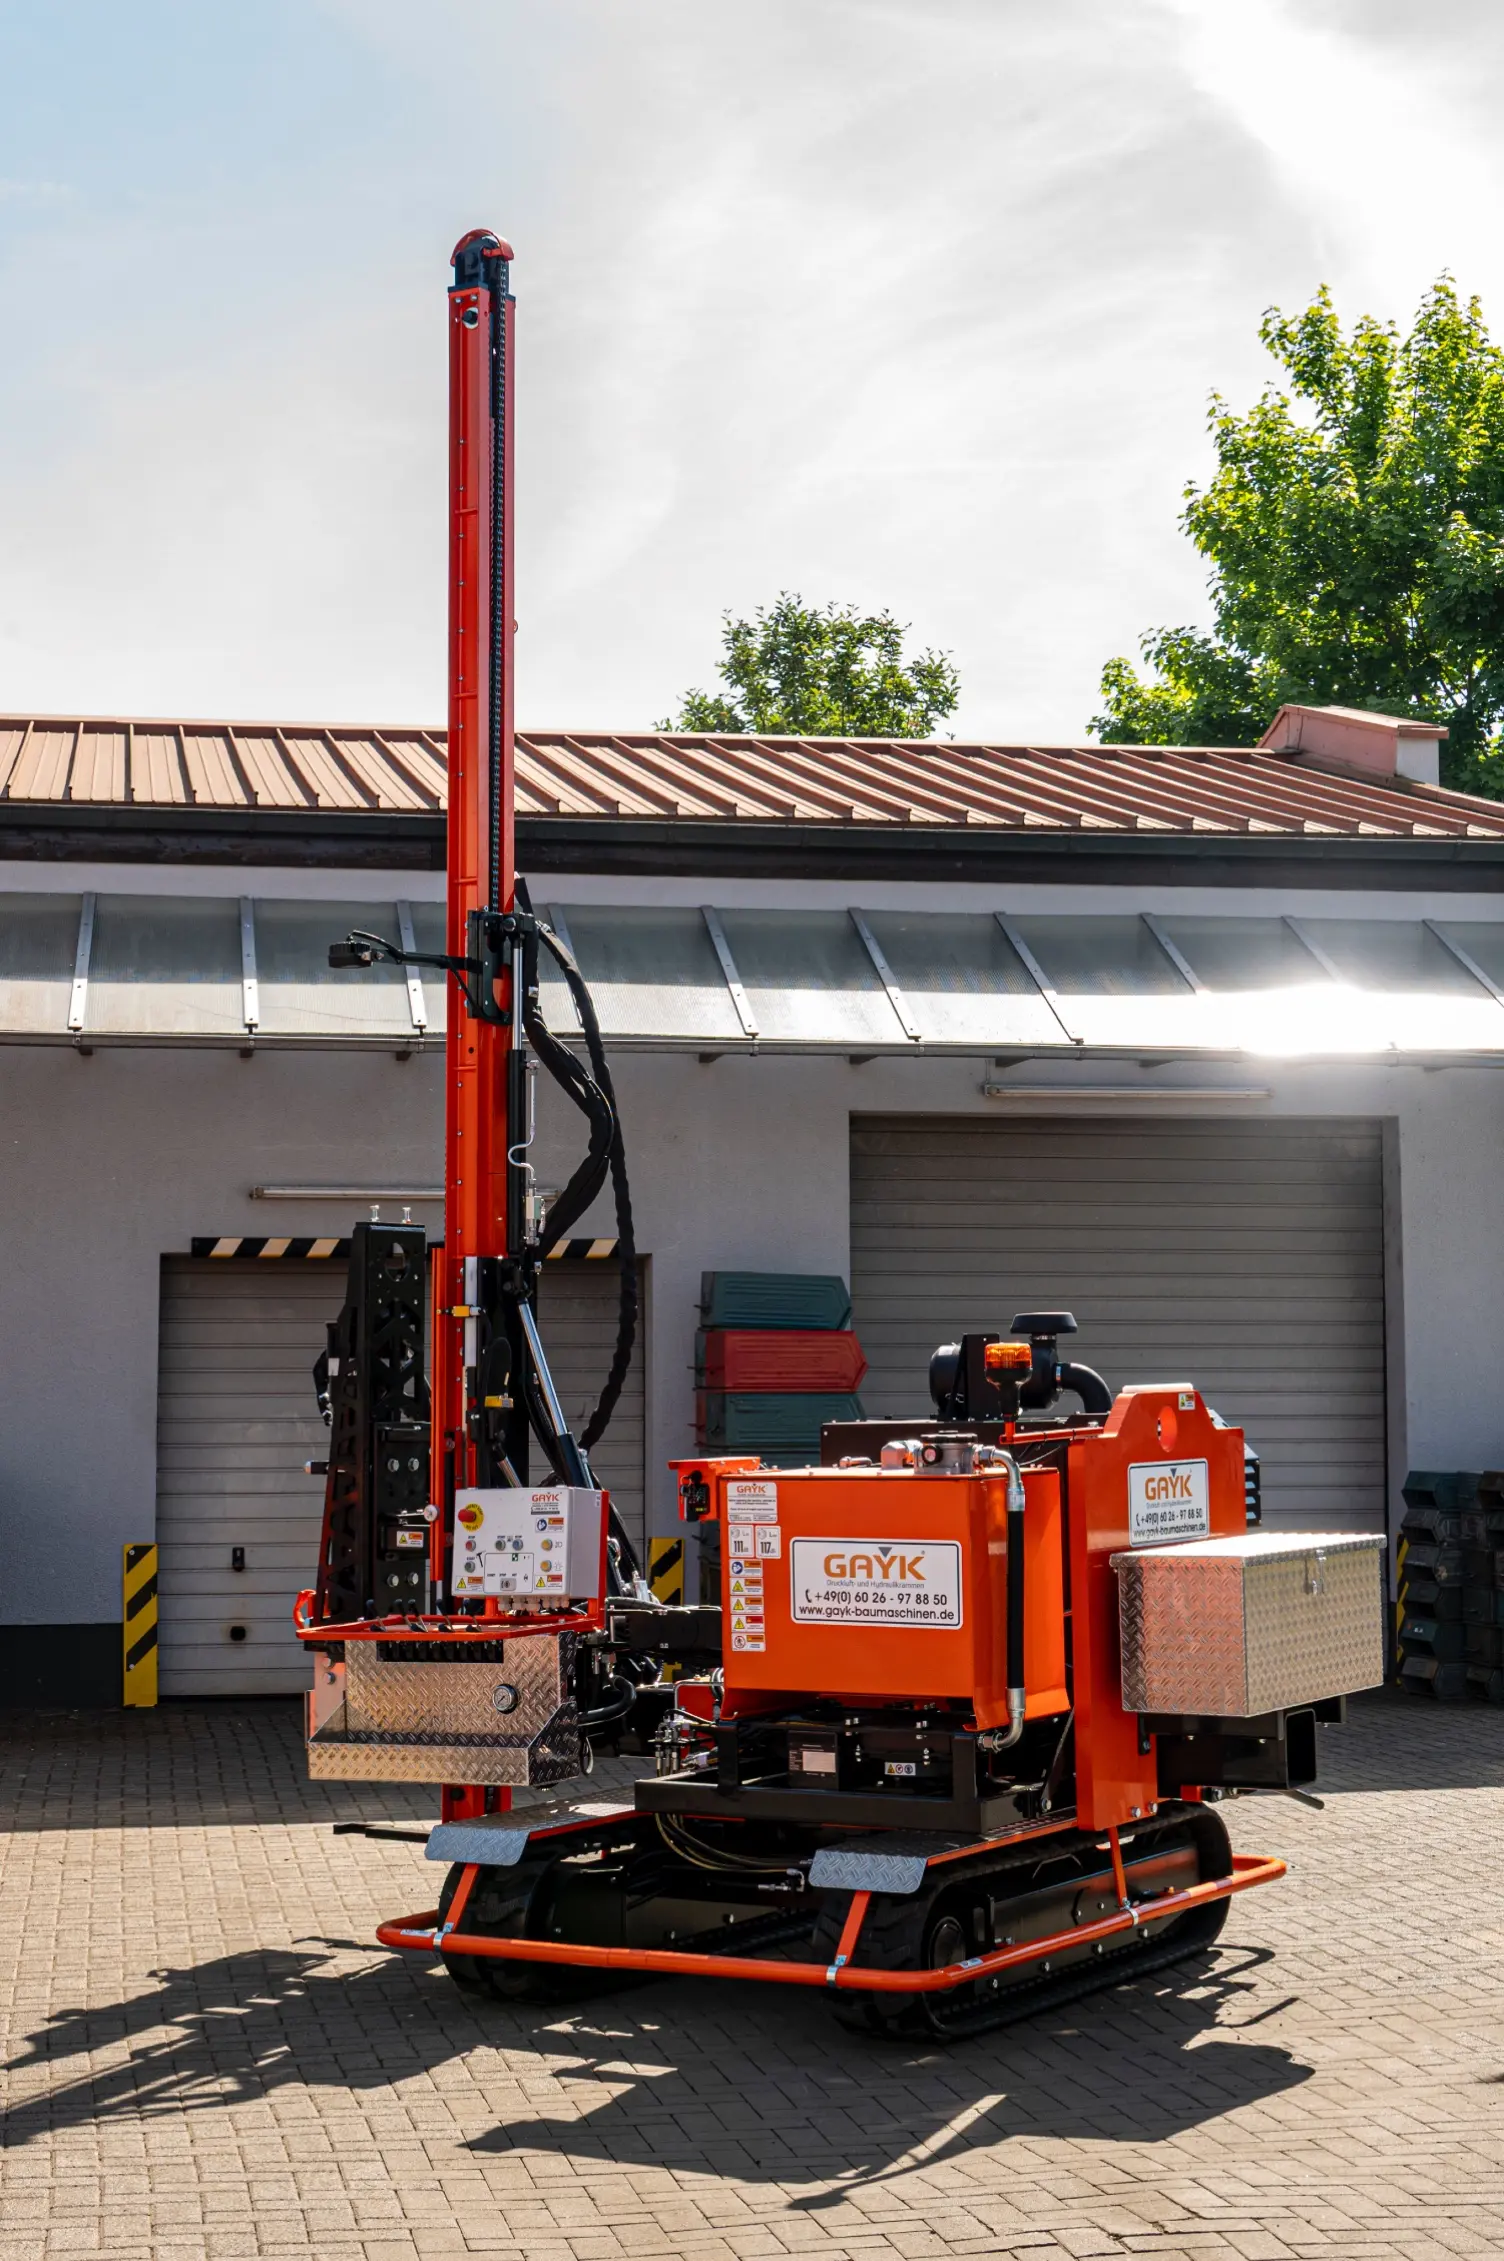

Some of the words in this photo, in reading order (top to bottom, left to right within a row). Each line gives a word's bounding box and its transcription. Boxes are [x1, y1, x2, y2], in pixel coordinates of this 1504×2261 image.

[736, 1485, 766, 1494] GAYK
[1145, 1475, 1193, 1500] GAYK
[532, 1493, 560, 1502] GAYK
[760, 1541, 772, 1554] 117
[823, 1553, 927, 1581] GAYK
[814, 1591, 851, 1605] +49(0)
[854, 1592, 869, 1603] 60
[872, 1592, 886, 1604] 26
[897, 1593, 911, 1604] 97
[915, 1593, 929, 1605] 88
[933, 1594, 948, 1605] 50
[799, 1605, 954, 1621] www.gayk-baumaschinen.de
